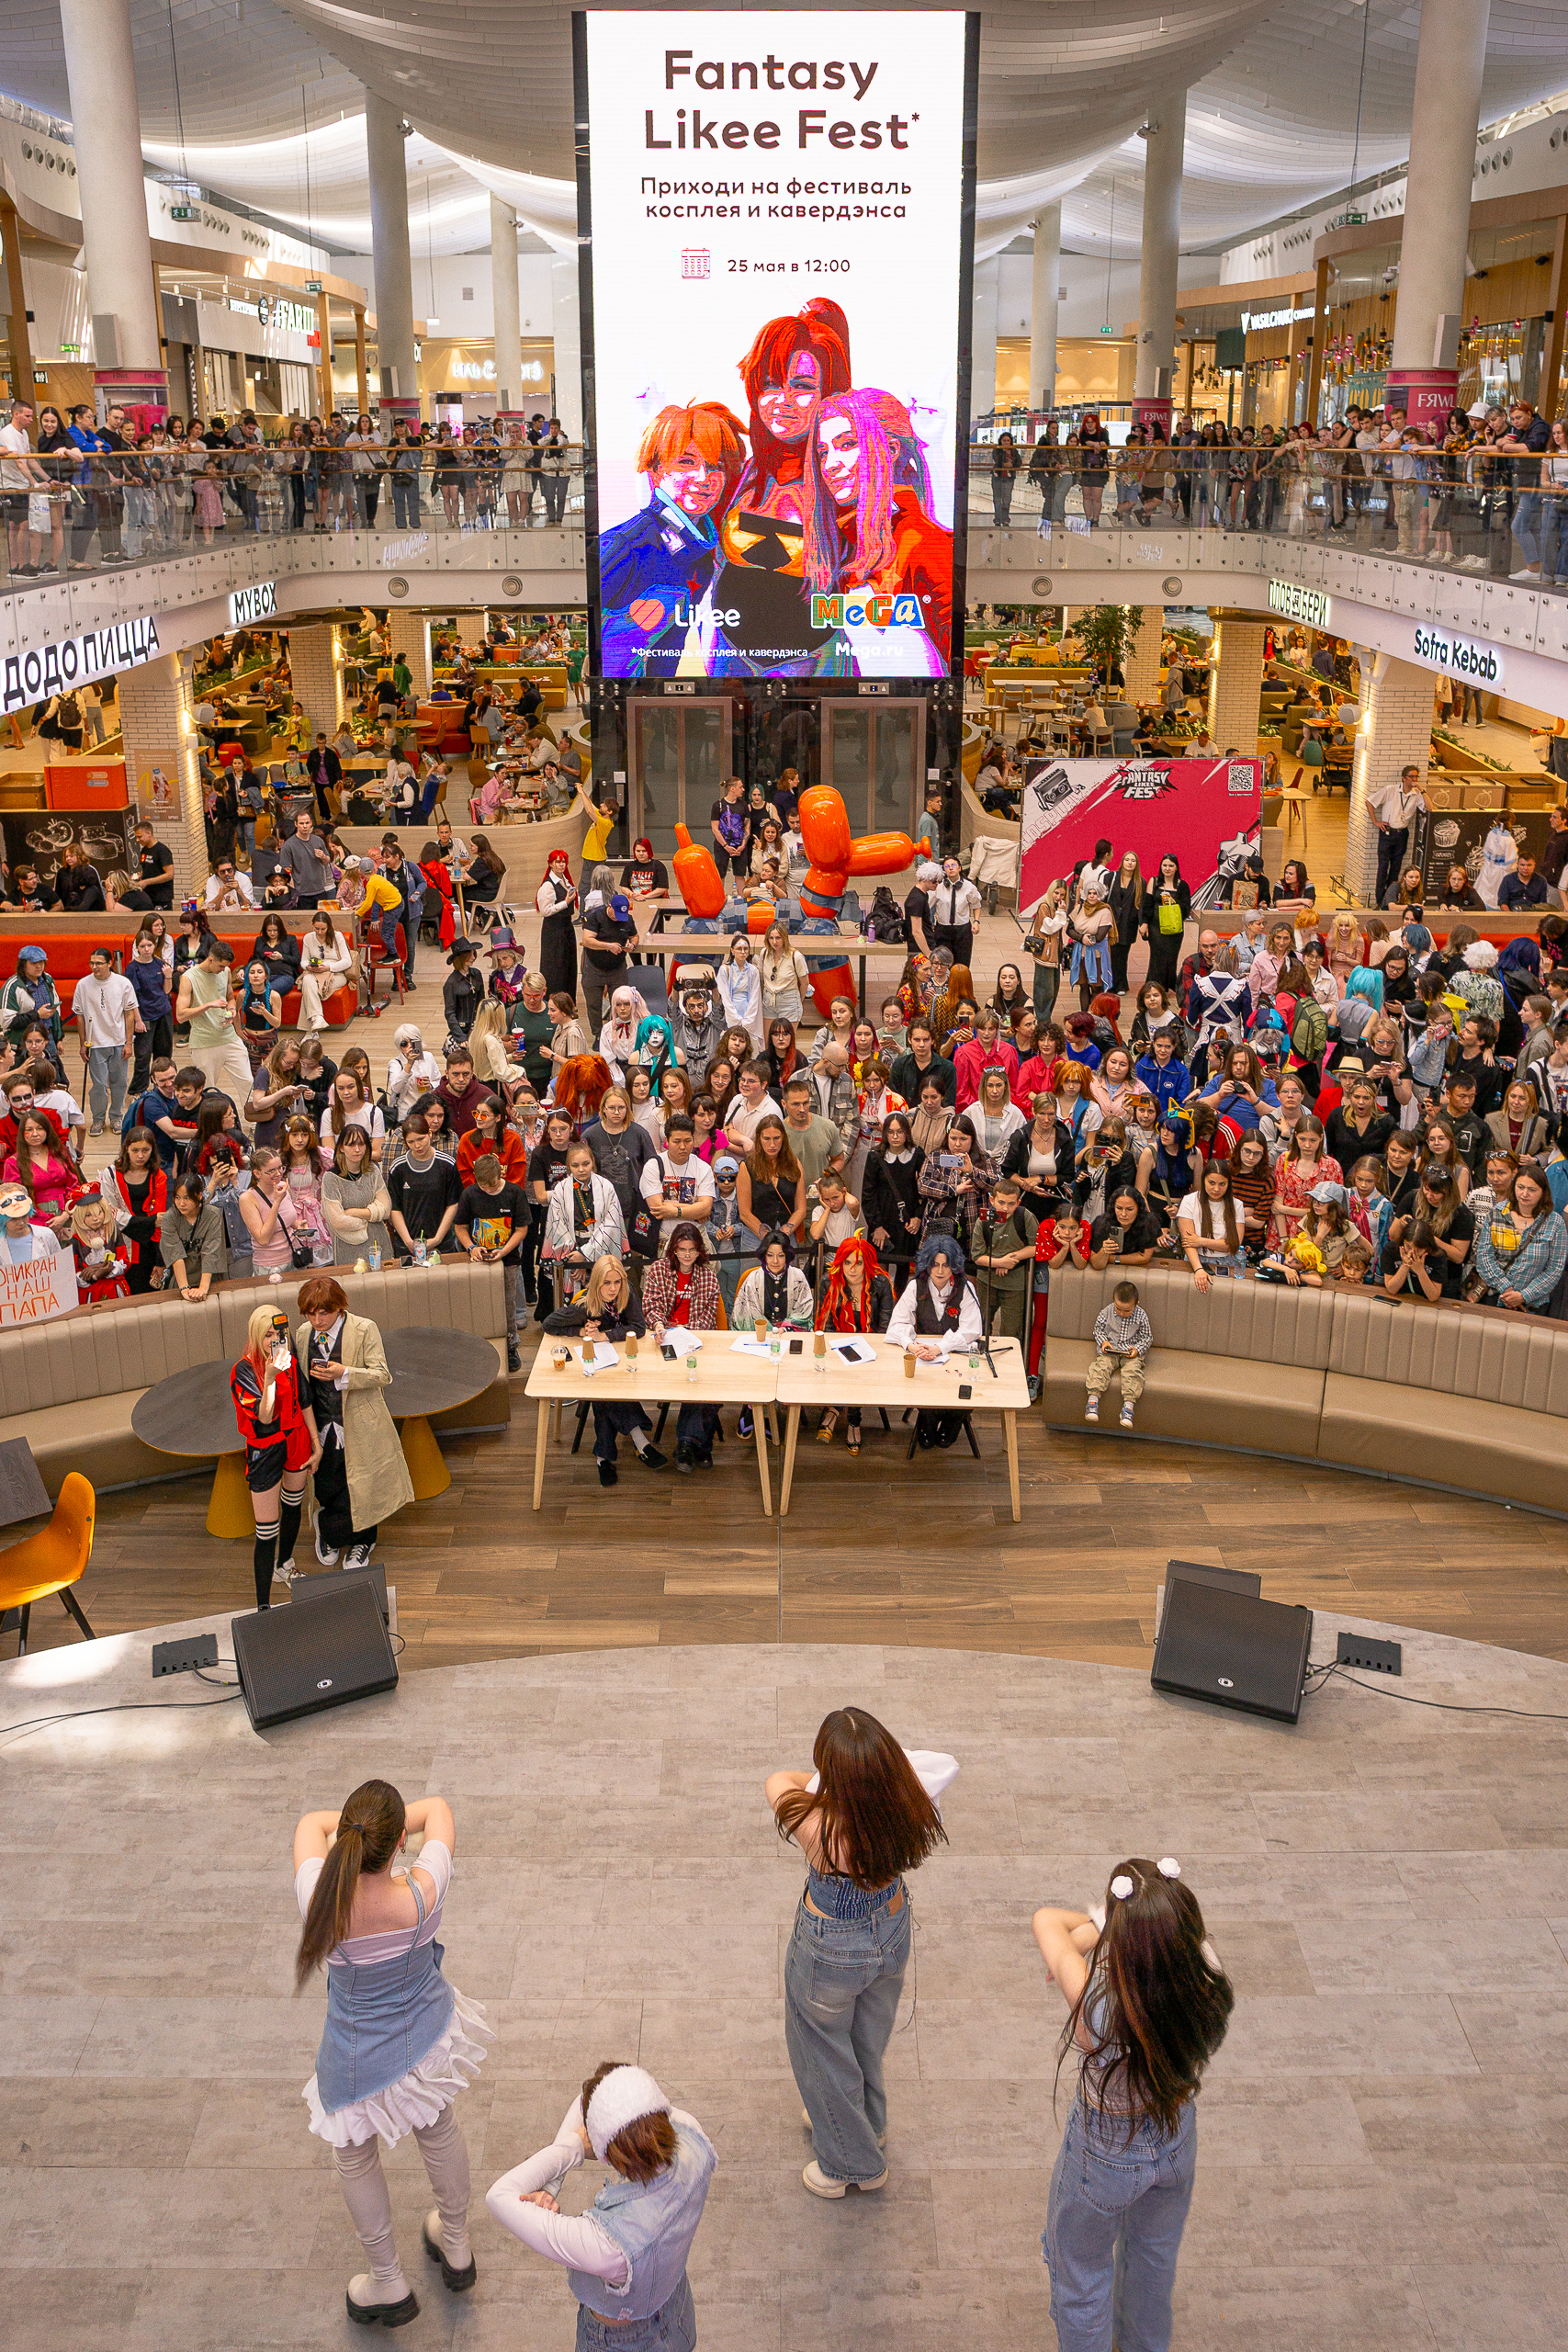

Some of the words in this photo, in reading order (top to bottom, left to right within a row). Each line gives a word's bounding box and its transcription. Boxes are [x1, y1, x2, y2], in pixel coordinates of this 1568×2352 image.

[665, 50, 879, 102] Fantasy
[645, 108, 781, 150] Likee
[640, 176, 745, 197] Приходи
[751, 181, 779, 196] на
[786, 176, 912, 198] фестиваль
[646, 203, 740, 219] косплея
[748, 204, 761, 219] и
[769, 203, 907, 222] кавердэнса
[728, 259, 748, 273] 25
[753, 261, 786, 273] мая
[790, 261, 800, 273] в
[805, 259, 851, 273] 12:00
[1250, 308, 1293, 330] VASILCHUKI
[234, 582, 278, 624] MYBOX
[1268, 580, 1292, 614] ПЛОВ
[1302, 591, 1326, 627] БЕРИ
[674, 604, 741, 628] Likee
[695, 649, 737, 658] косплея
[739, 649, 747, 658] и
[749, 649, 808, 660] кавердэнса
[835, 642, 904, 659] Mega.ru
[1414, 628, 1448, 663] Sofra
[1451, 639, 1497, 682] Kebab
[4, 640, 78, 711] ДОДО
[83, 616, 160, 674] ПИЦЦА
[1122, 771, 1170, 786] FANTASY
[1122, 786, 1165, 799] FEST
[7, 1275, 50, 1300] НАШ
[0, 1292, 60, 1324] ПАПА
